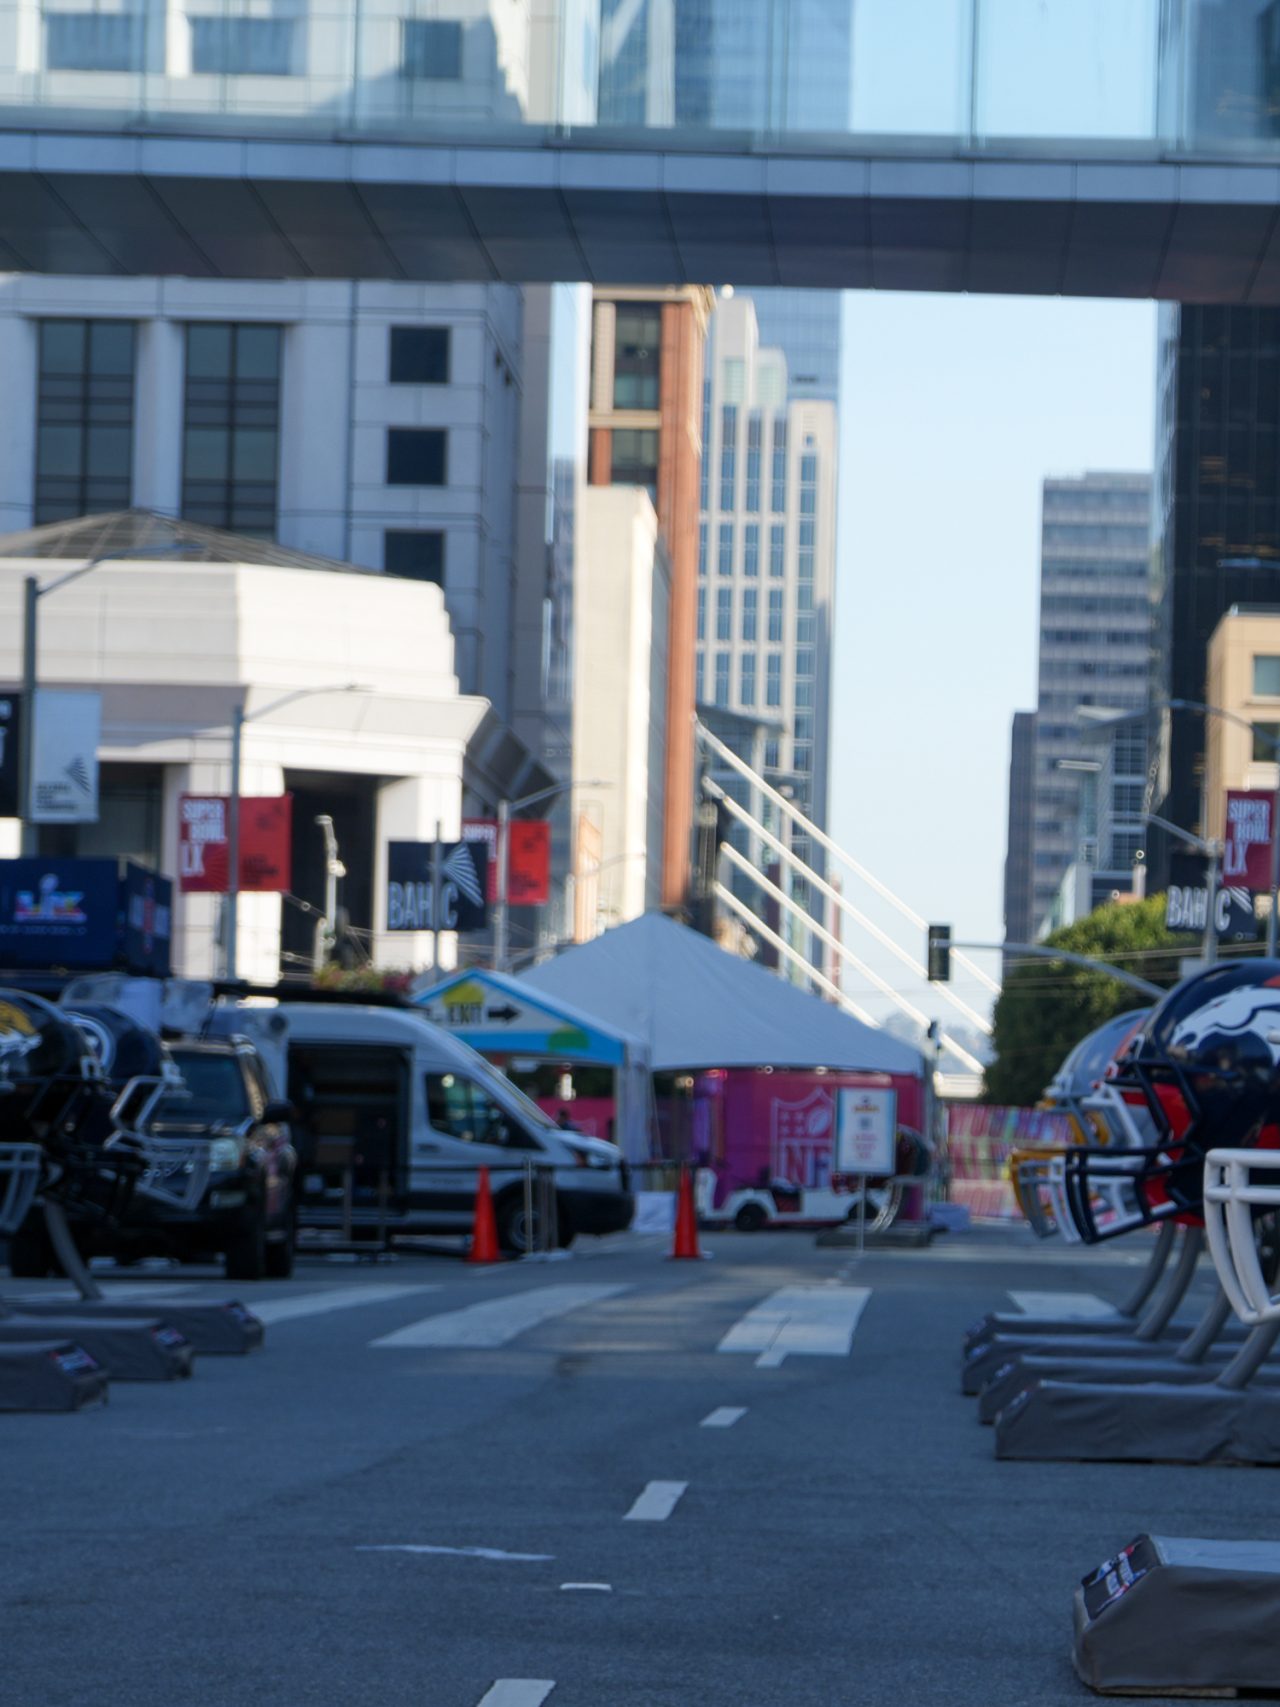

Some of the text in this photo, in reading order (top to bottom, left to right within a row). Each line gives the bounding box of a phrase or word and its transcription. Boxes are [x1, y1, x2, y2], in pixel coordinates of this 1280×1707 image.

[183, 799, 225, 822] SUPER
[1228, 799, 1271, 822] SUPER
[190, 819, 228, 844] BOWL
[1234, 819, 1272, 844] BOWL
[180, 841, 205, 876] LX
[1224, 839, 1249, 876] LX
[447, 1002, 482, 1025] EXIT
